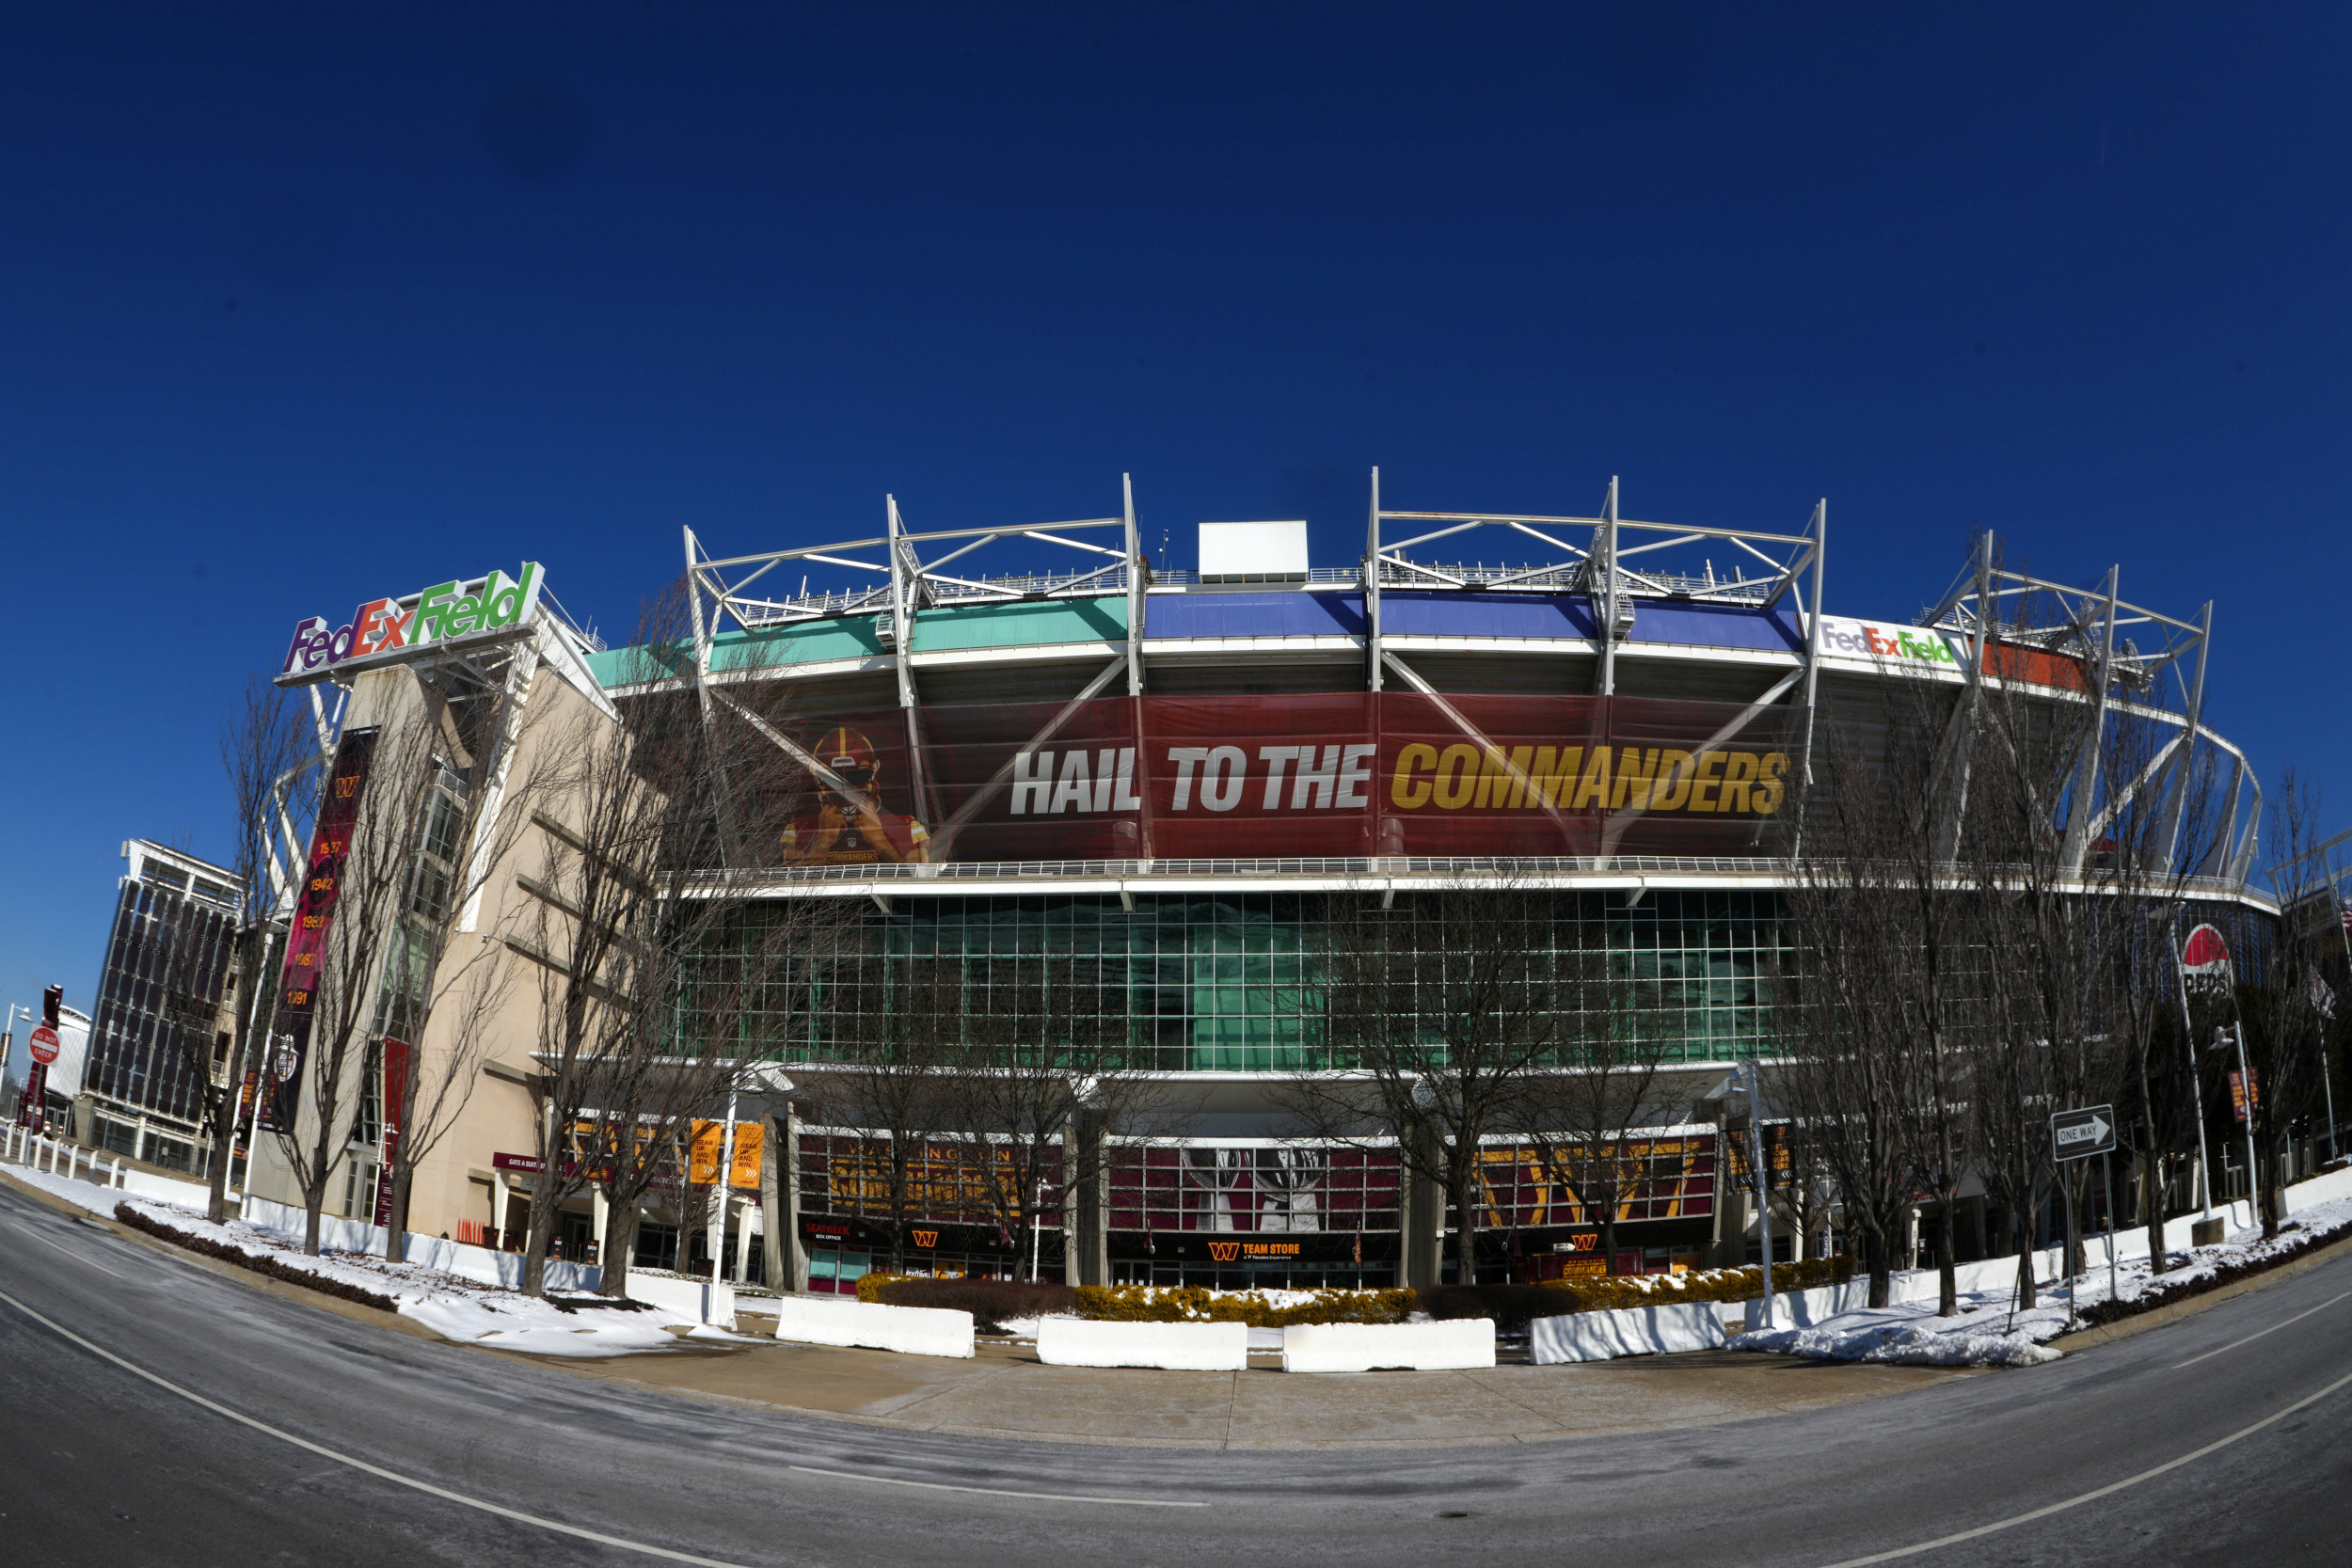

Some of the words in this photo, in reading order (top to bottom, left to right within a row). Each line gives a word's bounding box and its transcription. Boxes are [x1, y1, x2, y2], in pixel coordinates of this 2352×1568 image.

[282, 561, 546, 674] FedExField
[1820, 621, 1955, 663] FedExField
[1010, 747, 1141, 815] HAIL
[1168, 745, 1248, 812] TO
[1258, 743, 1377, 810] THE
[1391, 742, 1791, 815] COMMANDERS
[310, 878, 334, 891] 1942
[302, 915, 325, 928] 1982
[35, 1031, 44, 1040] DO
[45, 1035, 57, 1045] NOT
[34, 1048, 53, 1059] ENTER
[2060, 1129, 2078, 1142] ONE
[2080, 1125, 2097, 1138] WAY
[509, 1158, 521, 1166] GATE
[525, 1160, 539, 1168] SUIT
[805, 1223, 850, 1236] SEATGEEK
[1243, 1243, 1268, 1254] TEAM
[1269, 1243, 1300, 1254] STORE
